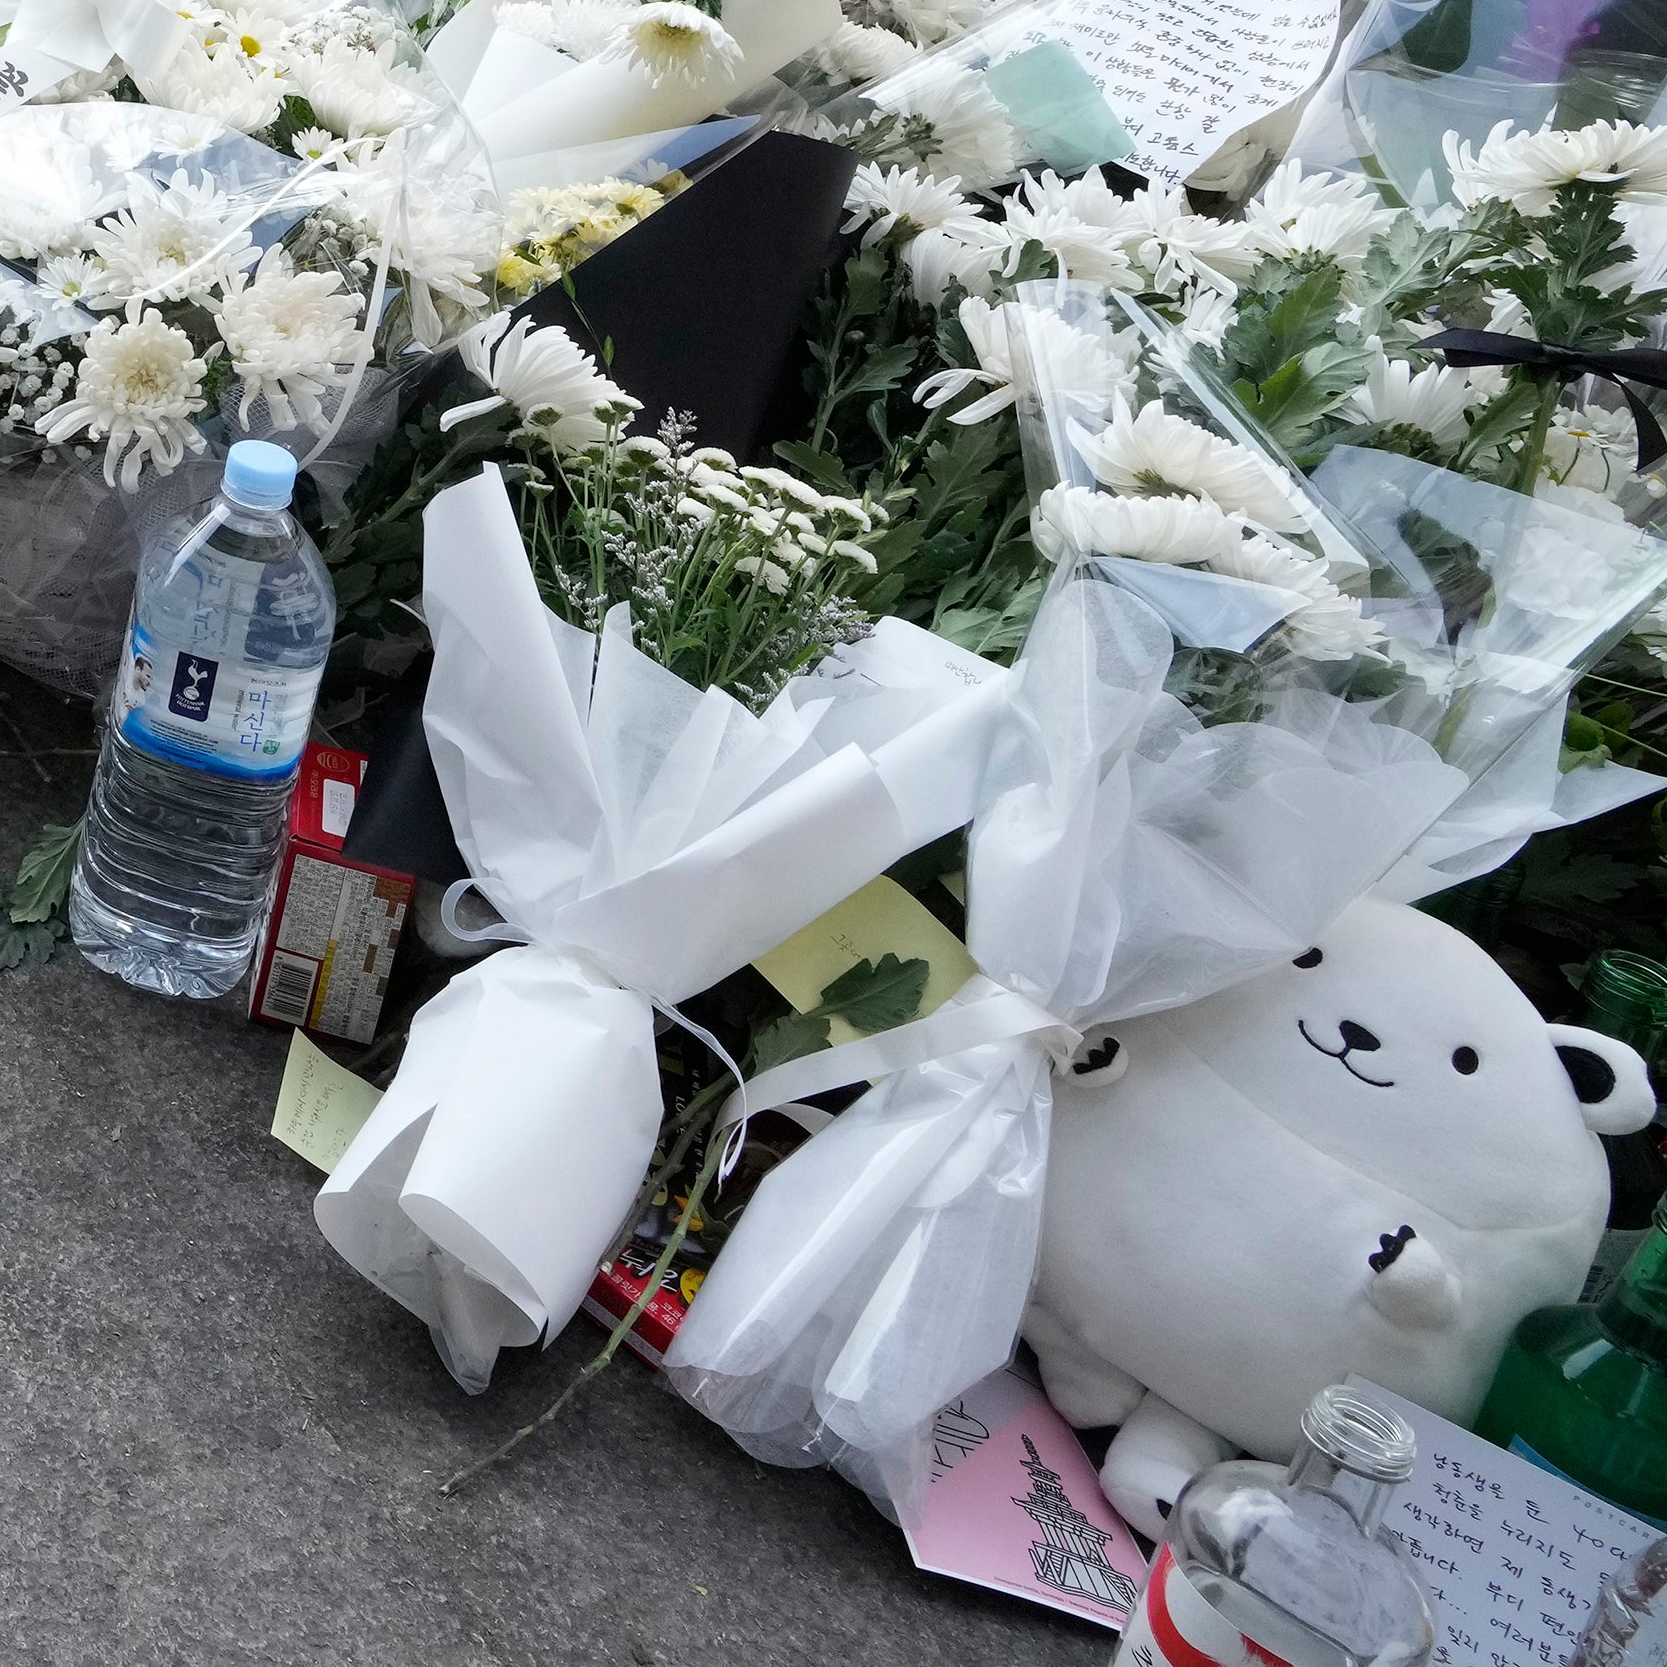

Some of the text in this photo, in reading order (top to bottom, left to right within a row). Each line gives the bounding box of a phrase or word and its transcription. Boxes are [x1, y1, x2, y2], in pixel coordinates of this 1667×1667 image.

[1248, 50, 1311, 71] 상황에서
[239, 690, 272, 753] 마신다
[1403, 1501, 1485, 1555] 생각하면
[1433, 1482, 1577, 1572] 청춘을 누리지도
[1571, 1494, 1657, 1540] POSTCAR
[1486, 1582, 1525, 1612] 부디
